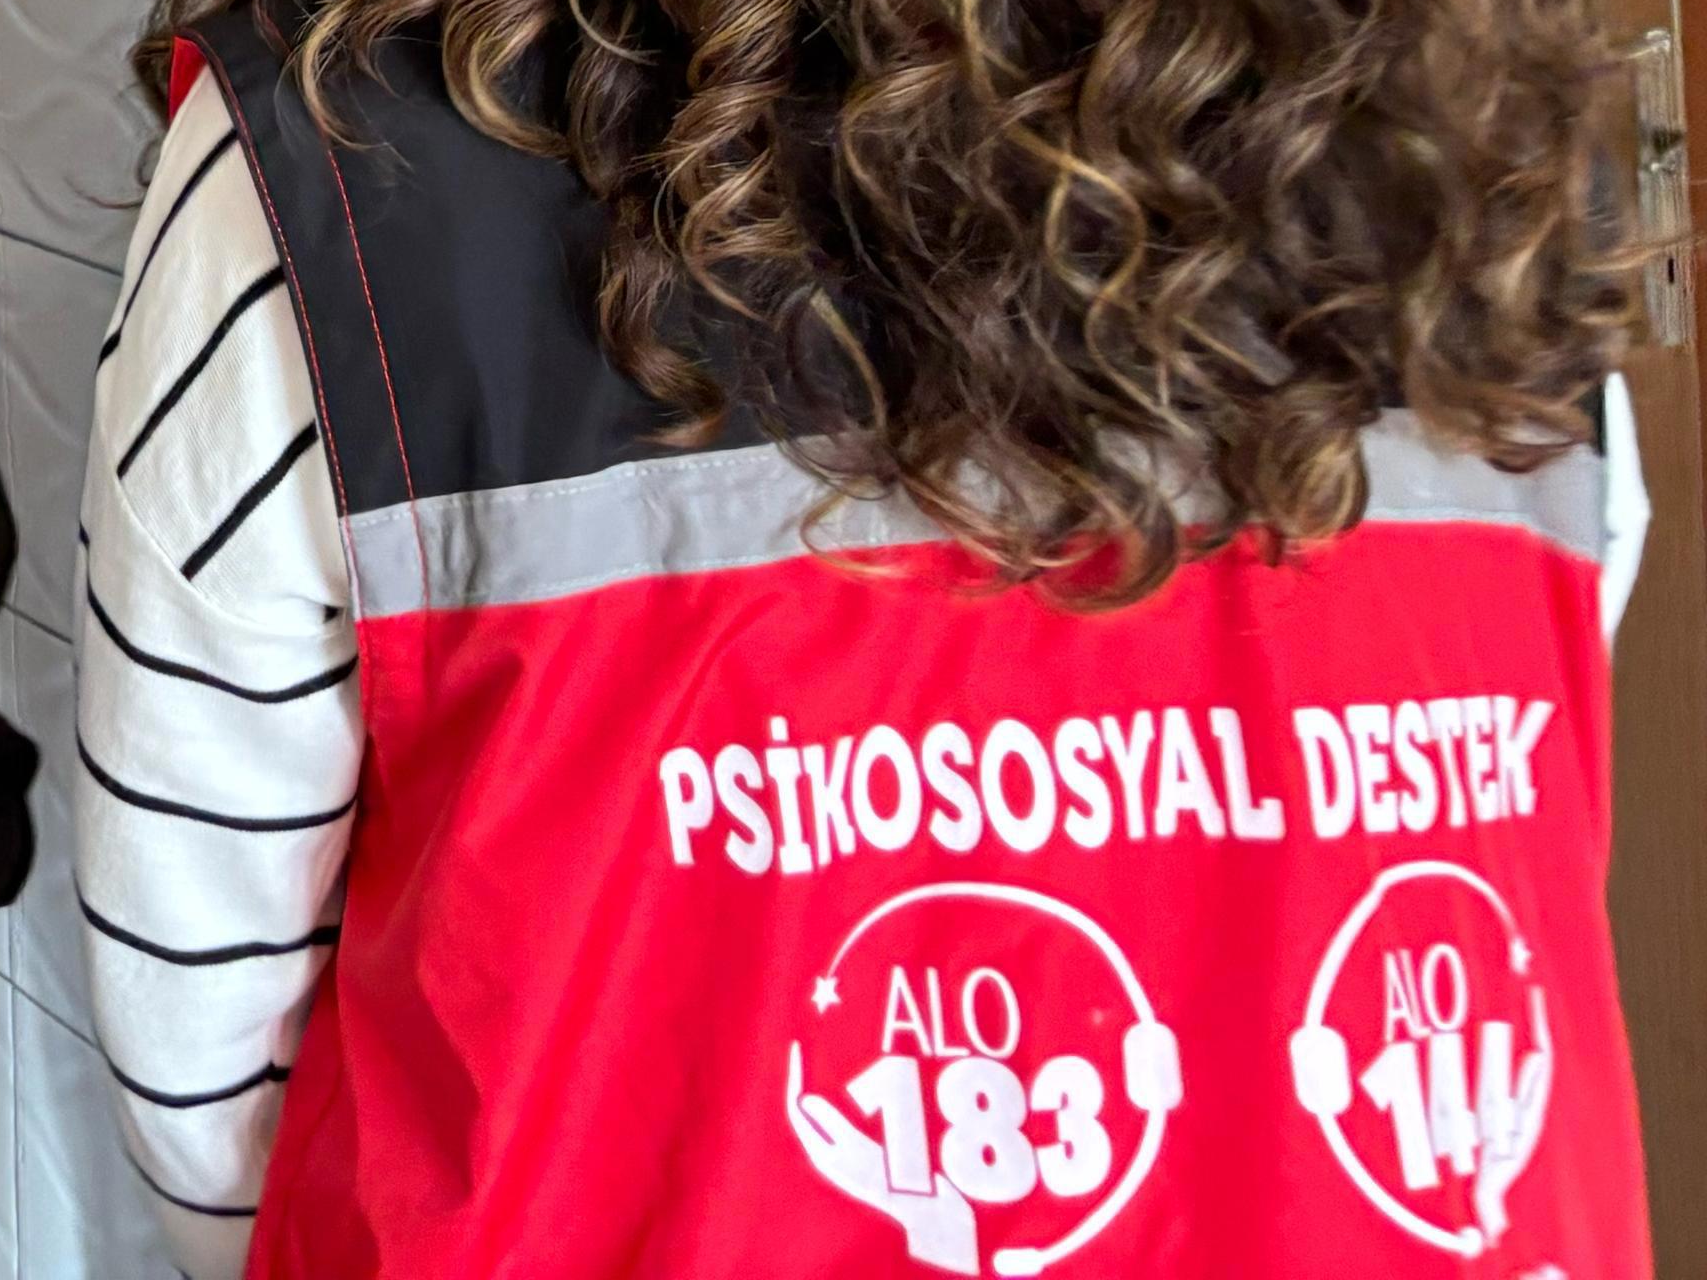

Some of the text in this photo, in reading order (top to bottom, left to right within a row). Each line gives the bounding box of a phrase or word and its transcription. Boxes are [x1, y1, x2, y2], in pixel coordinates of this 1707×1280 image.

[659, 695, 1554, 877] PSİKOSOSYAL DESTEK
[882, 965, 1021, 1059] ALO
[1384, 943, 1468, 1042] ALO
[846, 1055, 1112, 1203] 183
